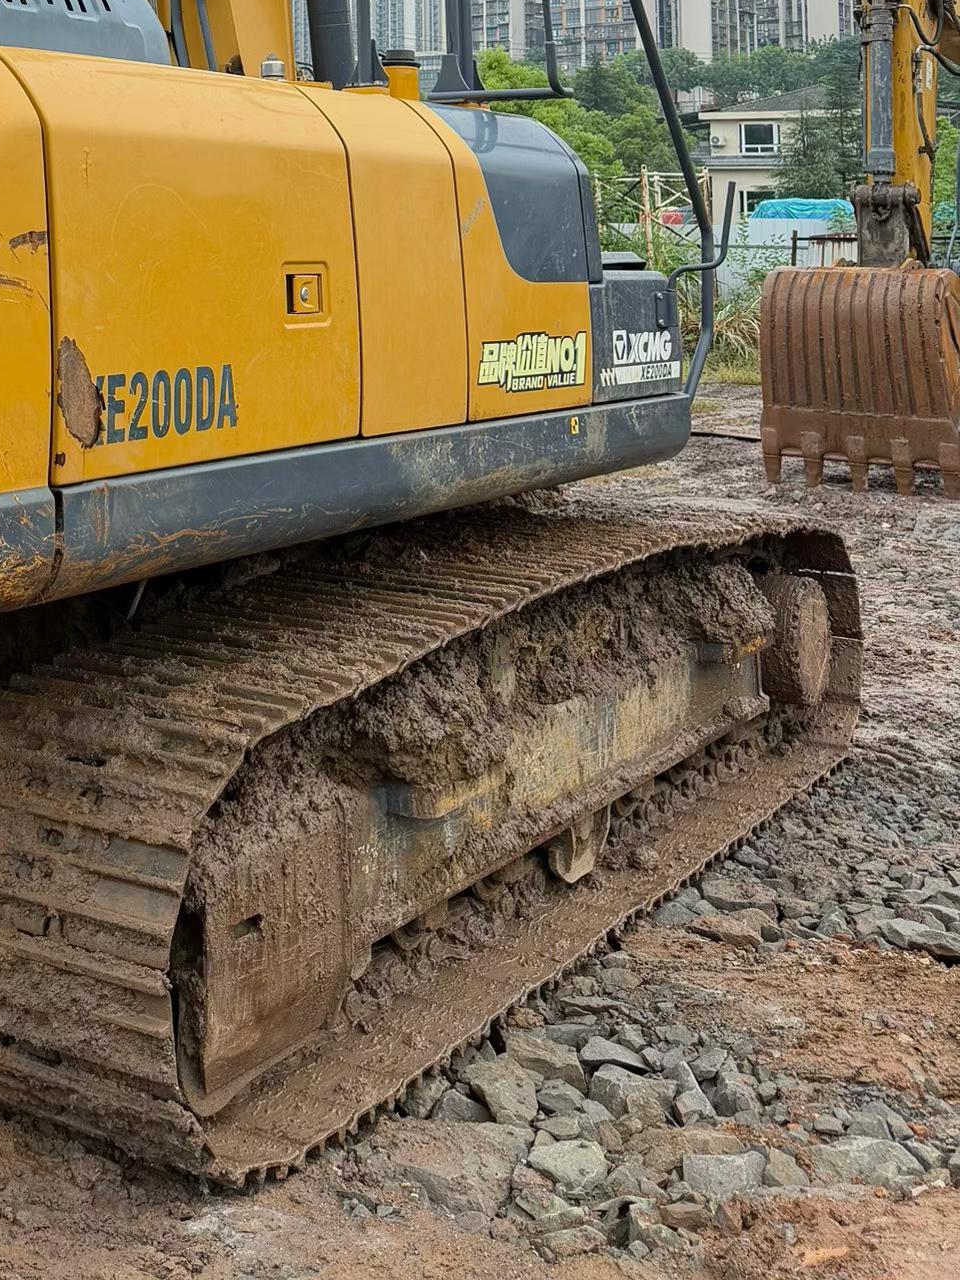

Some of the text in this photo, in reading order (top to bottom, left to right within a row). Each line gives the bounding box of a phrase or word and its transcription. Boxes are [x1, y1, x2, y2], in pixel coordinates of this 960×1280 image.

[627, 330, 672, 363] XCMG
[511, 372, 576, 391] BRAND VALUE
[640, 363, 672, 381] XE200DA
